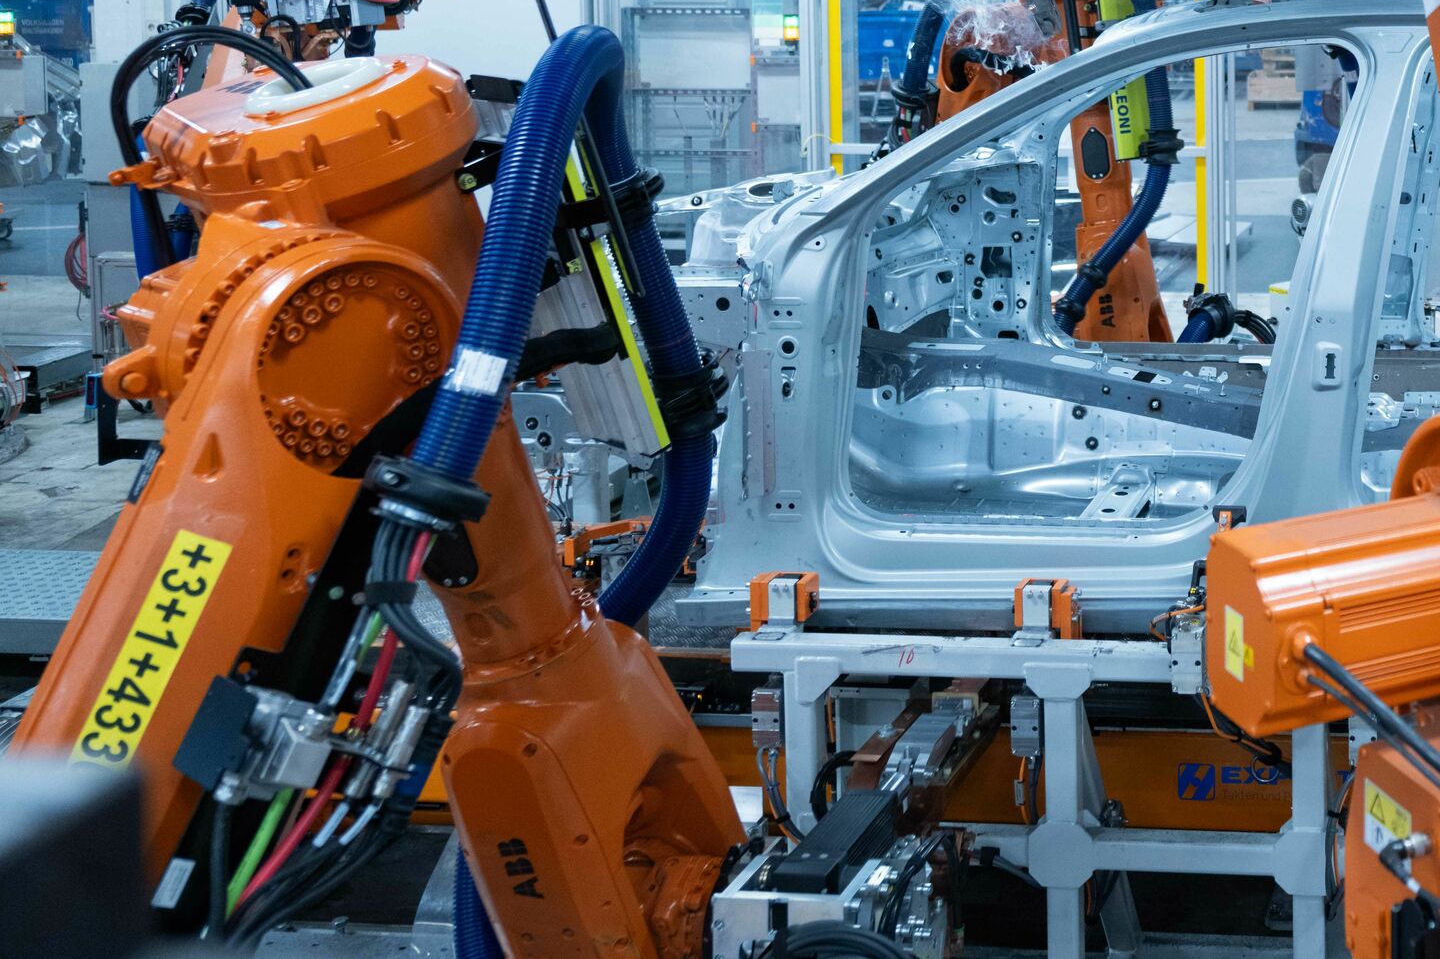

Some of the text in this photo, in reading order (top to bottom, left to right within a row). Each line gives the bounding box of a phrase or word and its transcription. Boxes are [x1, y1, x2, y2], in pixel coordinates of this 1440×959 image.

[1098, 293, 1116, 328] ABB
[74, 544, 213, 769] +3+1+433
[496, 838, 545, 899] ABB
